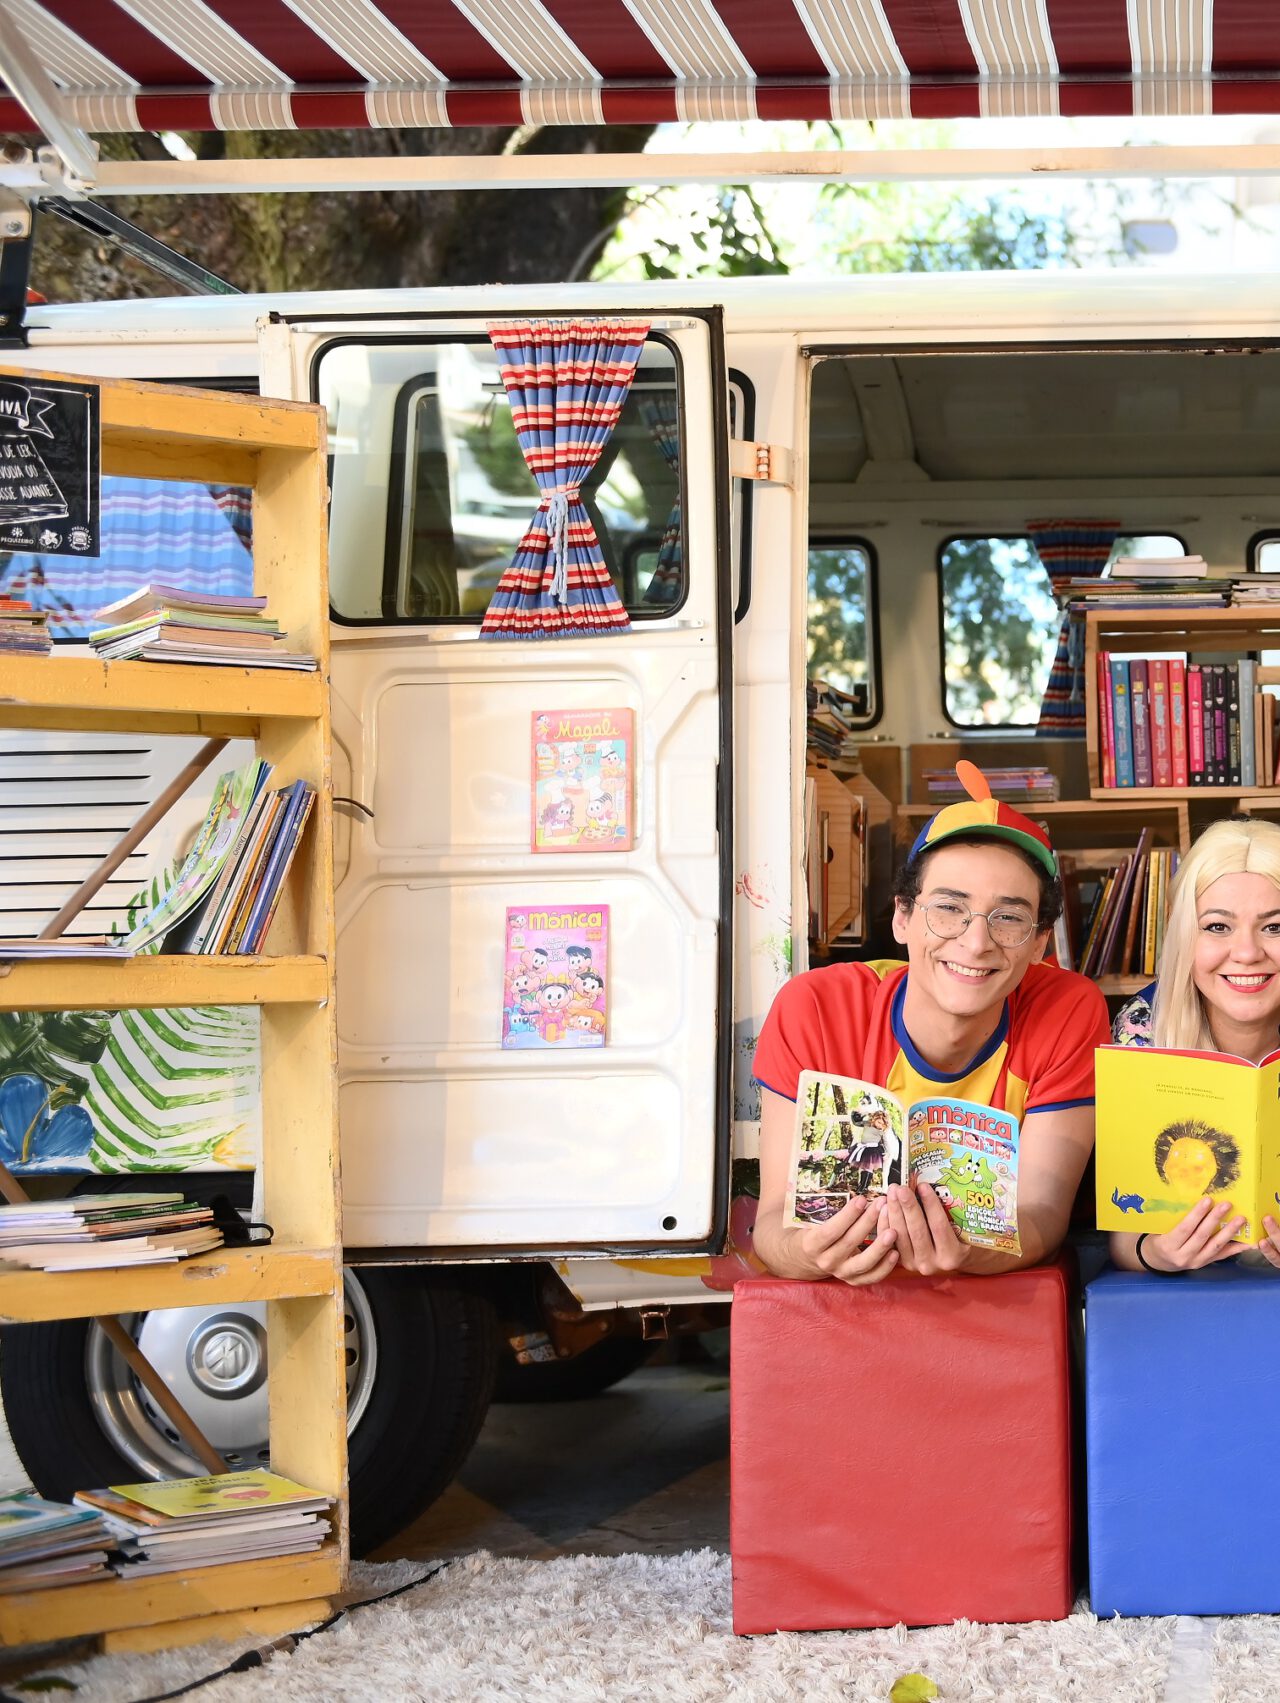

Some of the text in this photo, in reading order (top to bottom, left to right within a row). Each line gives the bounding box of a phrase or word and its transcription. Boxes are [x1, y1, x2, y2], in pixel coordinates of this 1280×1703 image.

[2, 444, 16, 458] DE
[25, 464, 39, 478] OU
[19, 484, 54, 499] ADIANTE
[553, 718, 621, 741] Magali
[967, 1189, 995, 1210] 500
[965, 1211, 975, 1219] DA
[968, 1220, 978, 1228] NO
